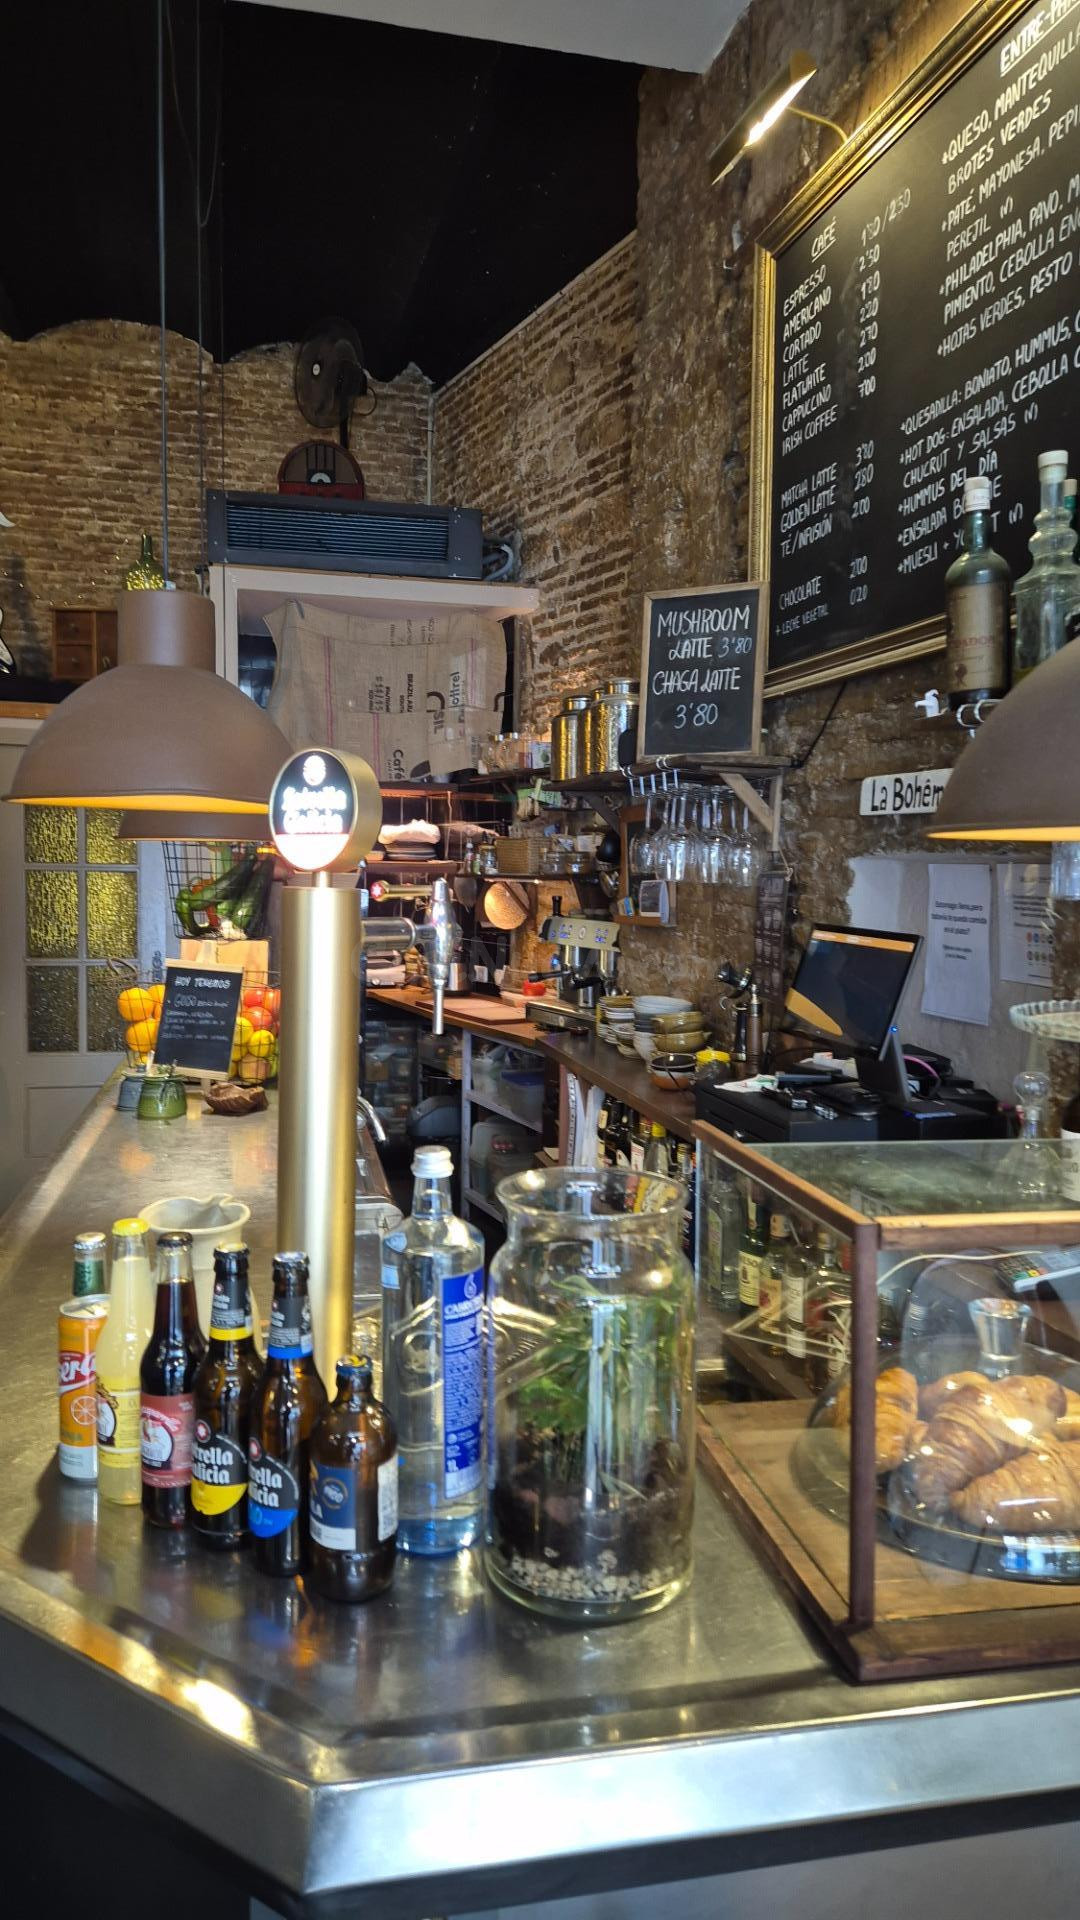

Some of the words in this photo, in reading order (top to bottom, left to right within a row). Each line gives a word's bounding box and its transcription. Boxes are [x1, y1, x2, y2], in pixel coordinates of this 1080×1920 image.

[948, 136, 995, 195] BROTES
[1000, 88, 1052, 146] VERDES
[1048, 103, 1080, 148] PEPI
[811, 216, 837, 258] CAFÉ
[946, 213, 991, 262] PEREJIL
[999, 226, 1055, 283] CEBOLLA
[783, 264, 827, 317] ESPRESSO
[783, 285, 832, 342] AMERICANO
[942, 317, 977, 357] HOJAS
[1029, 250, 1073, 299] PESTO
[783, 321, 822, 363] CORTADO
[783, 353, 809, 387] LATTE
[782, 383, 832, 433] CAPPUCCINO
[782, 429, 803, 457] IRISH
[804, 404, 838, 440] COFFEE
[904, 439, 924, 465] HOT
[1011, 353, 1068, 403] CEBOLLA
[903, 447, 951, 489] CHUCRUT
[957, 440, 965, 461] Y
[968, 412, 1016, 454] SALSAS
[781, 478, 808, 510] MATCHA
[811, 461, 838, 492] LATTE
[903, 478, 945, 517] HUMMUS
[979, 448, 998, 476] DÍA
[780, 497, 811, 533] GOLDEN
[811, 484, 837, 515] LATTE
[902, 506, 948, 547] ENSALADA
[903, 541, 938, 575] MUESLI
[779, 575, 822, 610] CHOCOLATE
[657, 604, 750, 638] MUSHROOM
[668, 636, 713, 661] LATTE
[718, 636, 753, 658] 3'80
[652, 668, 699, 695] CHAGA
[700, 666, 741, 693] LATTE
[674, 702, 719, 729] 3'80
[393, 750, 404, 780] Café
[871, 779, 888, 811] La
